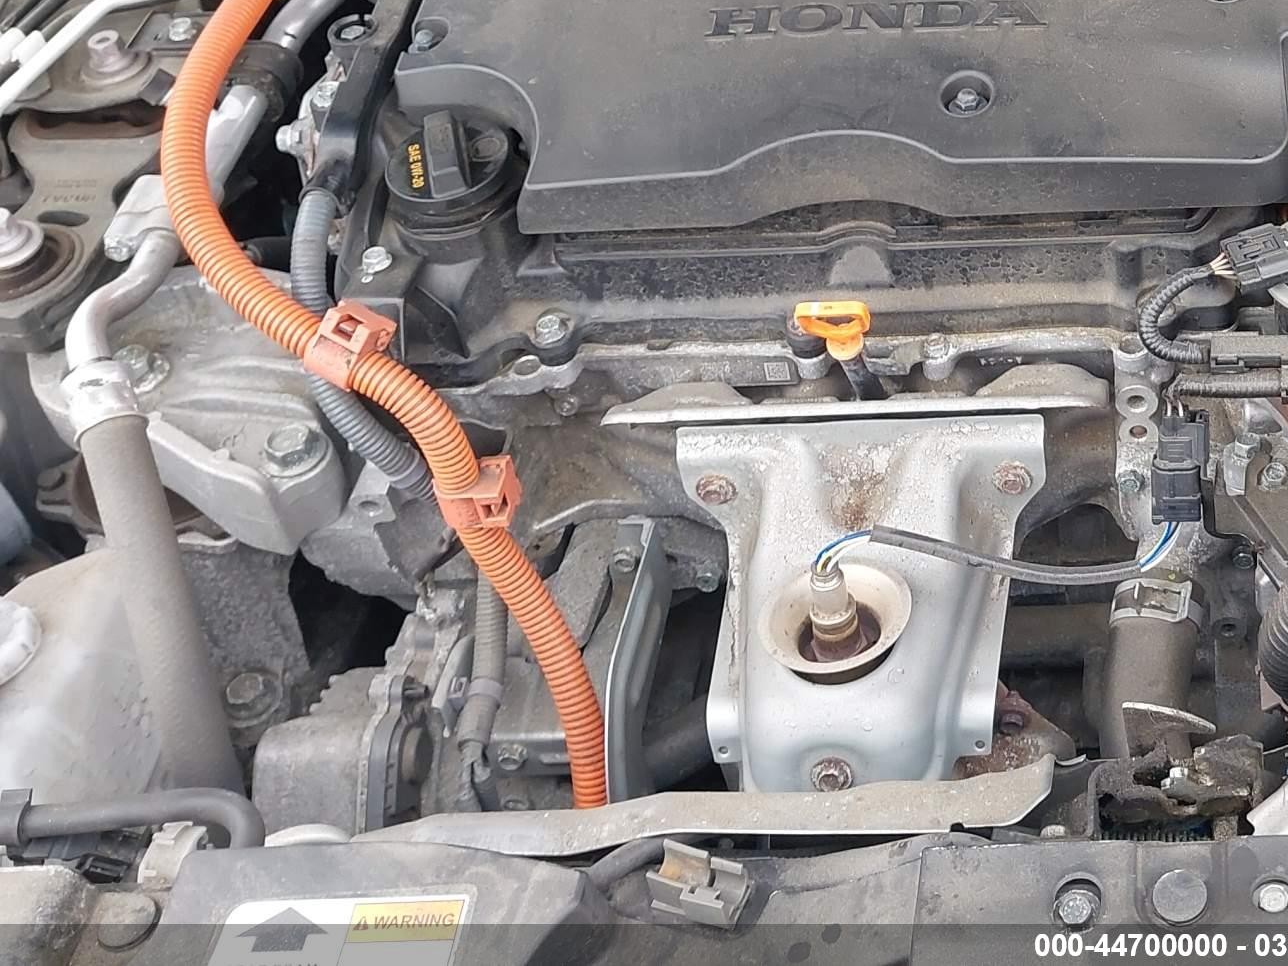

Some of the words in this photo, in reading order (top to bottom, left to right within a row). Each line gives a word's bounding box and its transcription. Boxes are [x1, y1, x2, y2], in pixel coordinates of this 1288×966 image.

[703, 0, 1048, 36] HONDA
[408, 144, 421, 162] SAE
[410, 163, 424, 188] 0W-20
[374, 913, 455, 930] WARNING
